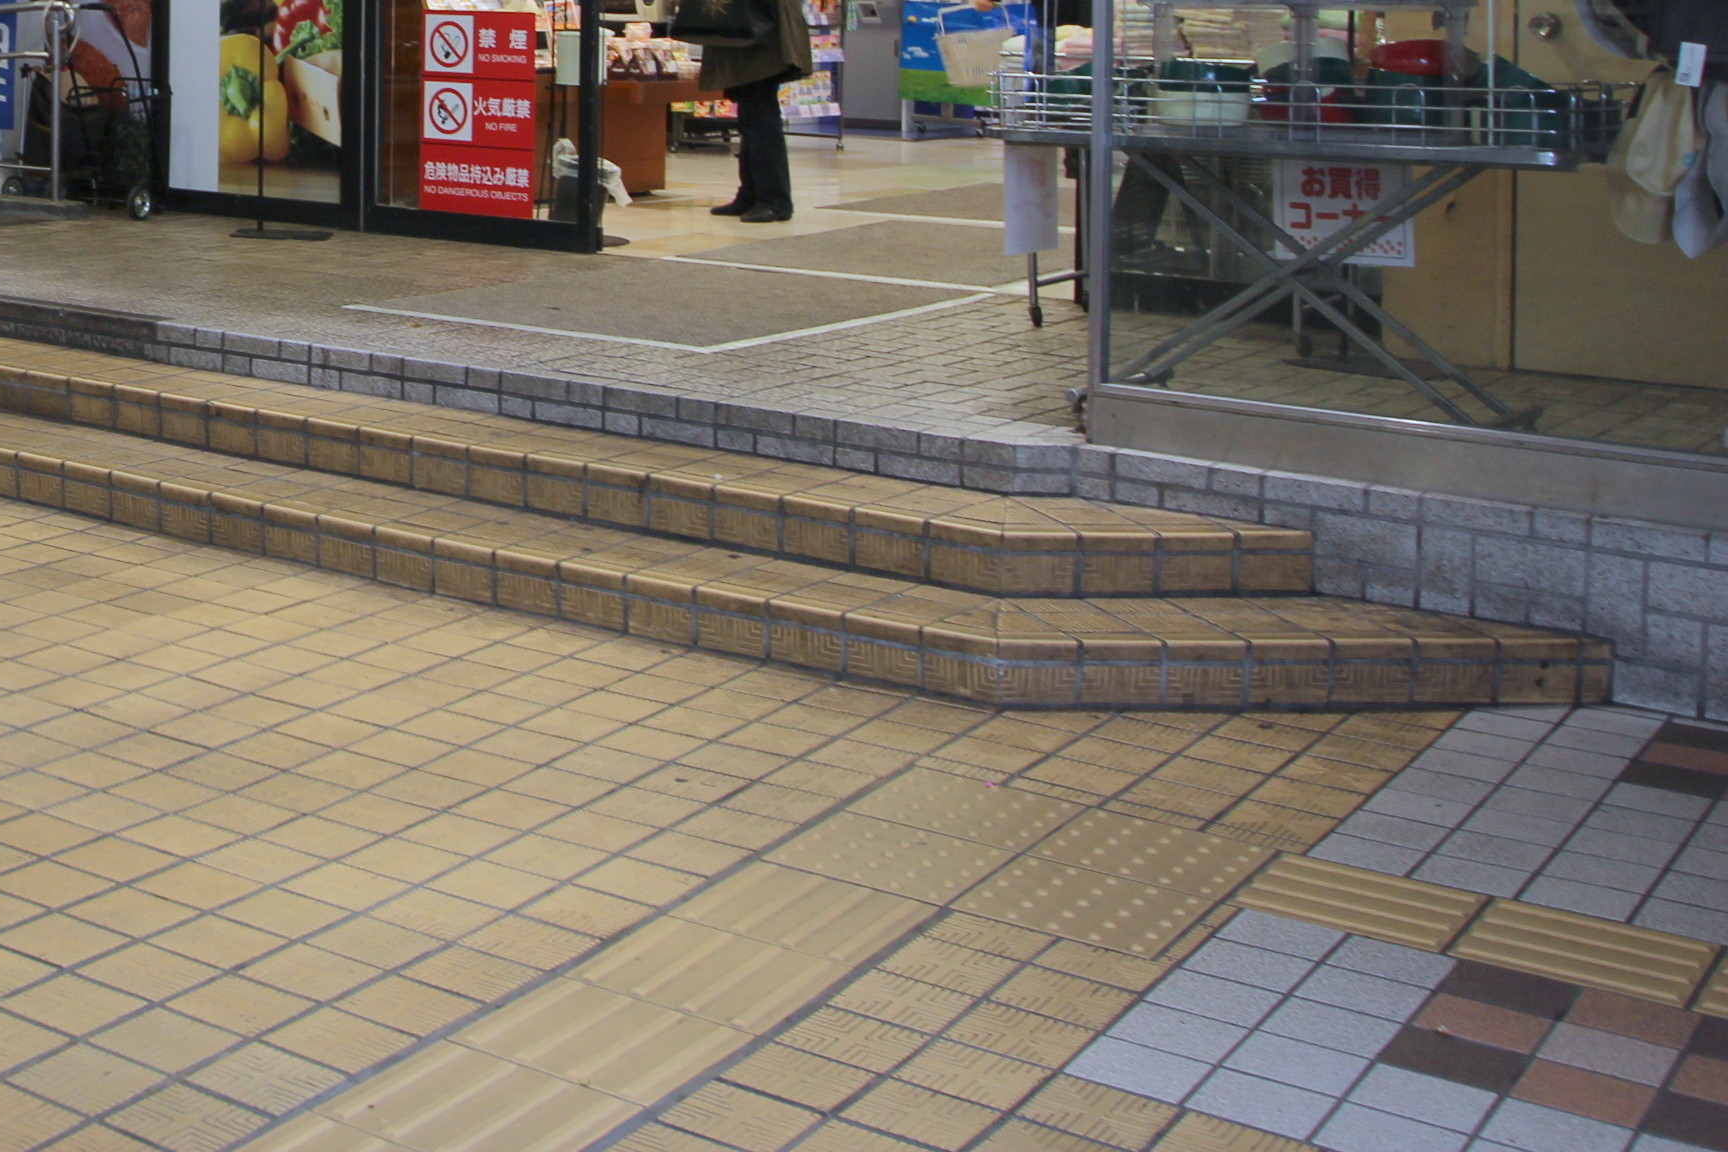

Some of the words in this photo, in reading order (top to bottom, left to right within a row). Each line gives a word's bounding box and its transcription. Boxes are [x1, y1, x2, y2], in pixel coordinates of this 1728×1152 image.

[478, 53, 490, 63] NO
[490, 53, 527, 64] SMOKING
[473, 96, 531, 119] 火気厳禁
[484, 122, 497, 132] NO
[498, 123, 518, 133] FIRE
[423, 160, 530, 188] 危険物品持込み厳禁
[1301, 165, 1381, 201] お買得
[423, 184, 436, 195] NO
[437, 186, 490, 200] DANGEROUS
[490, 189, 529, 202] OBJECTS
